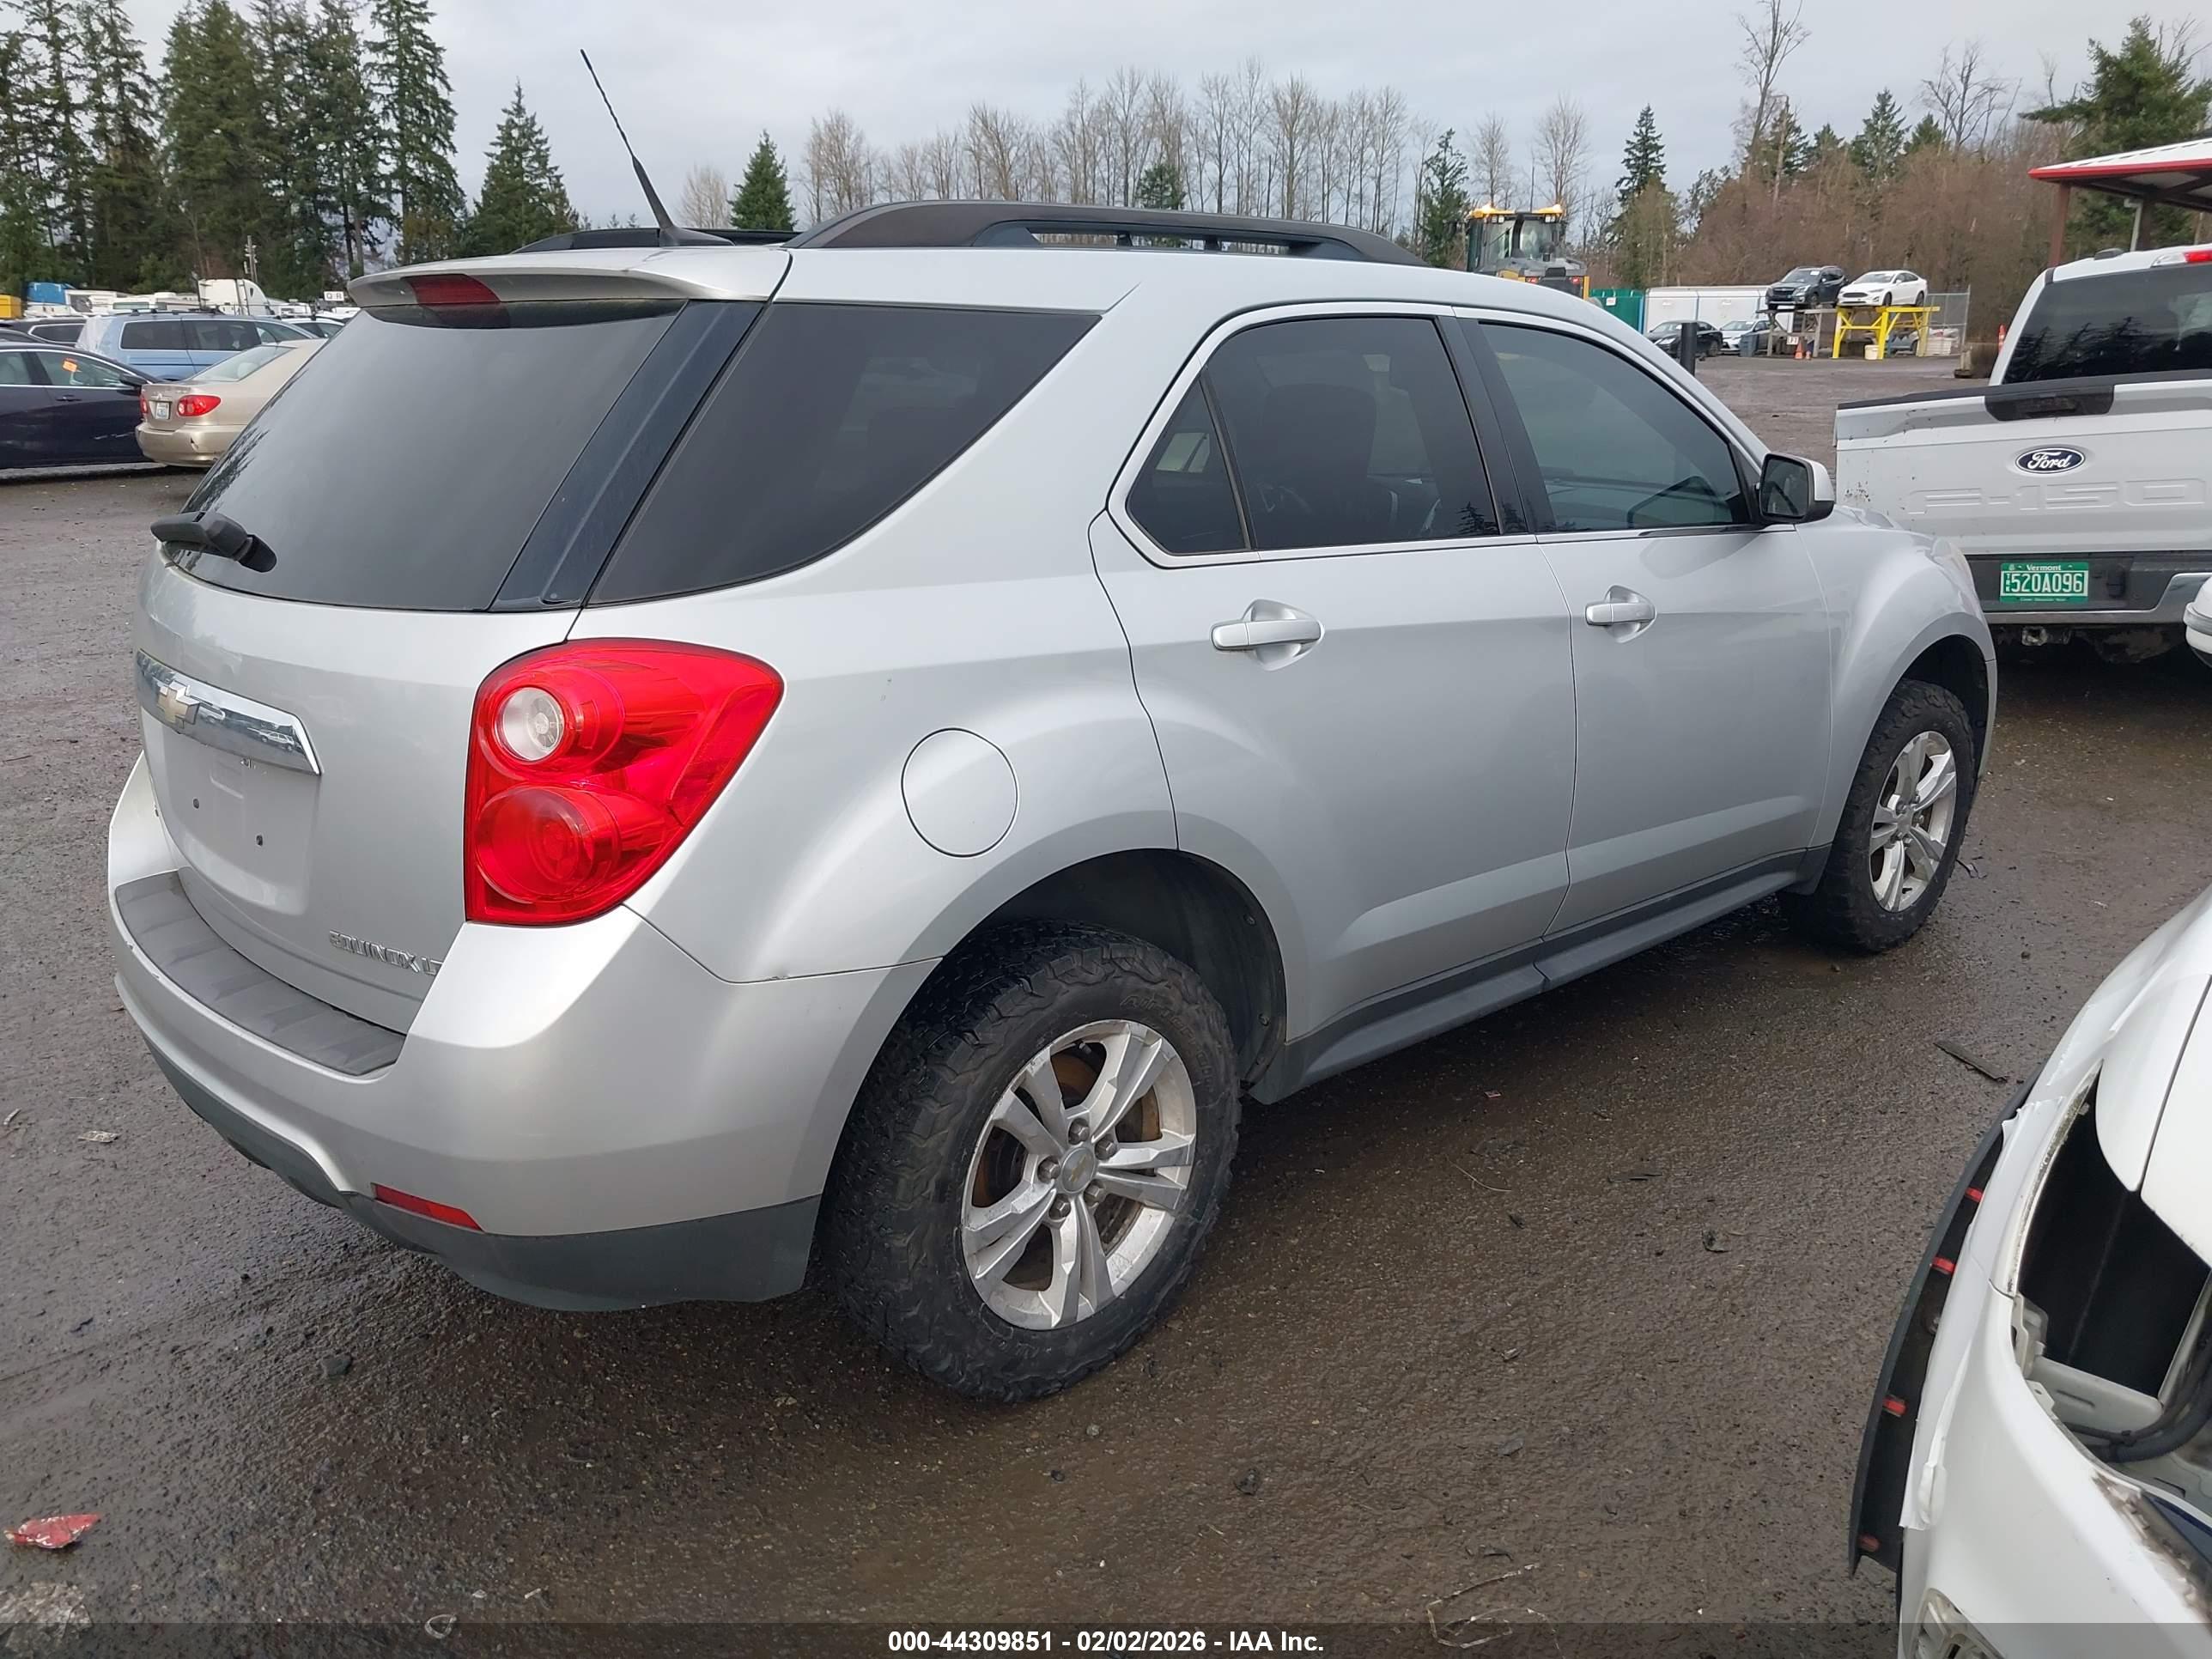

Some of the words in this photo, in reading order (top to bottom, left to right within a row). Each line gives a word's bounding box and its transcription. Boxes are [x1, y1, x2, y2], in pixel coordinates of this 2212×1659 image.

[2027, 451, 2073, 470] Ford
[1908, 477, 2206, 515] F-150
[2011, 573, 2083, 592] 520A096
